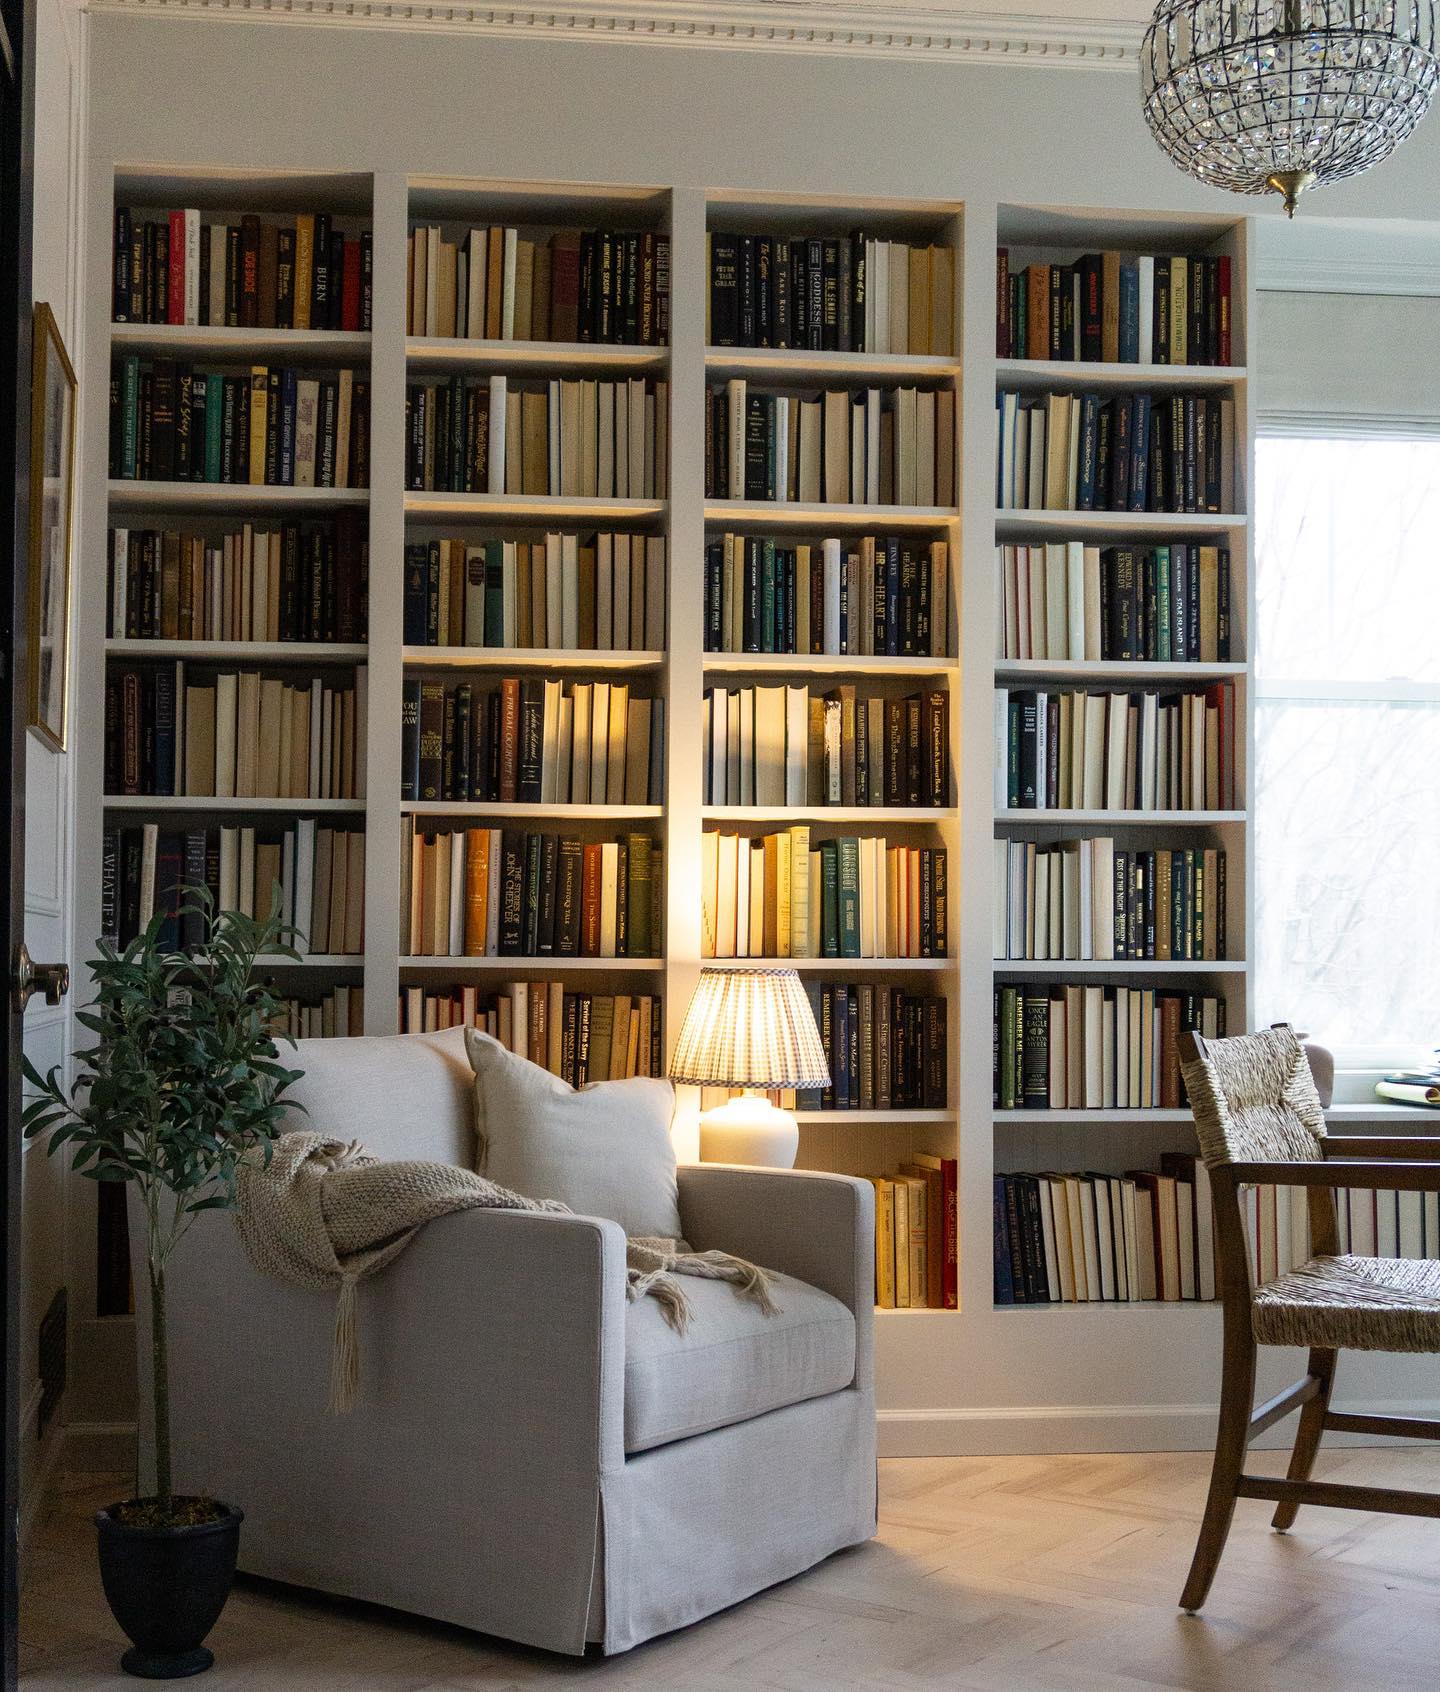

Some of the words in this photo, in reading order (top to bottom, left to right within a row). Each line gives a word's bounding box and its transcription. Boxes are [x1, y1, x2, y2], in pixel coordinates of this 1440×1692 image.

[813, 274, 821, 322] GODDESS
[876, 552, 885, 565] HR
[876, 586, 885, 620] HEART
[1176, 598, 1184, 614] STAR
[1176, 617, 1184, 643] ISLAND
[403, 702, 418, 710] OU
[403, 716, 417, 724] AW
[104, 854, 114, 898] WHAT
[507, 852, 515, 876] JOHN
[505, 880, 514, 923] CHEEVER
[824, 1038, 830, 1049] ME
